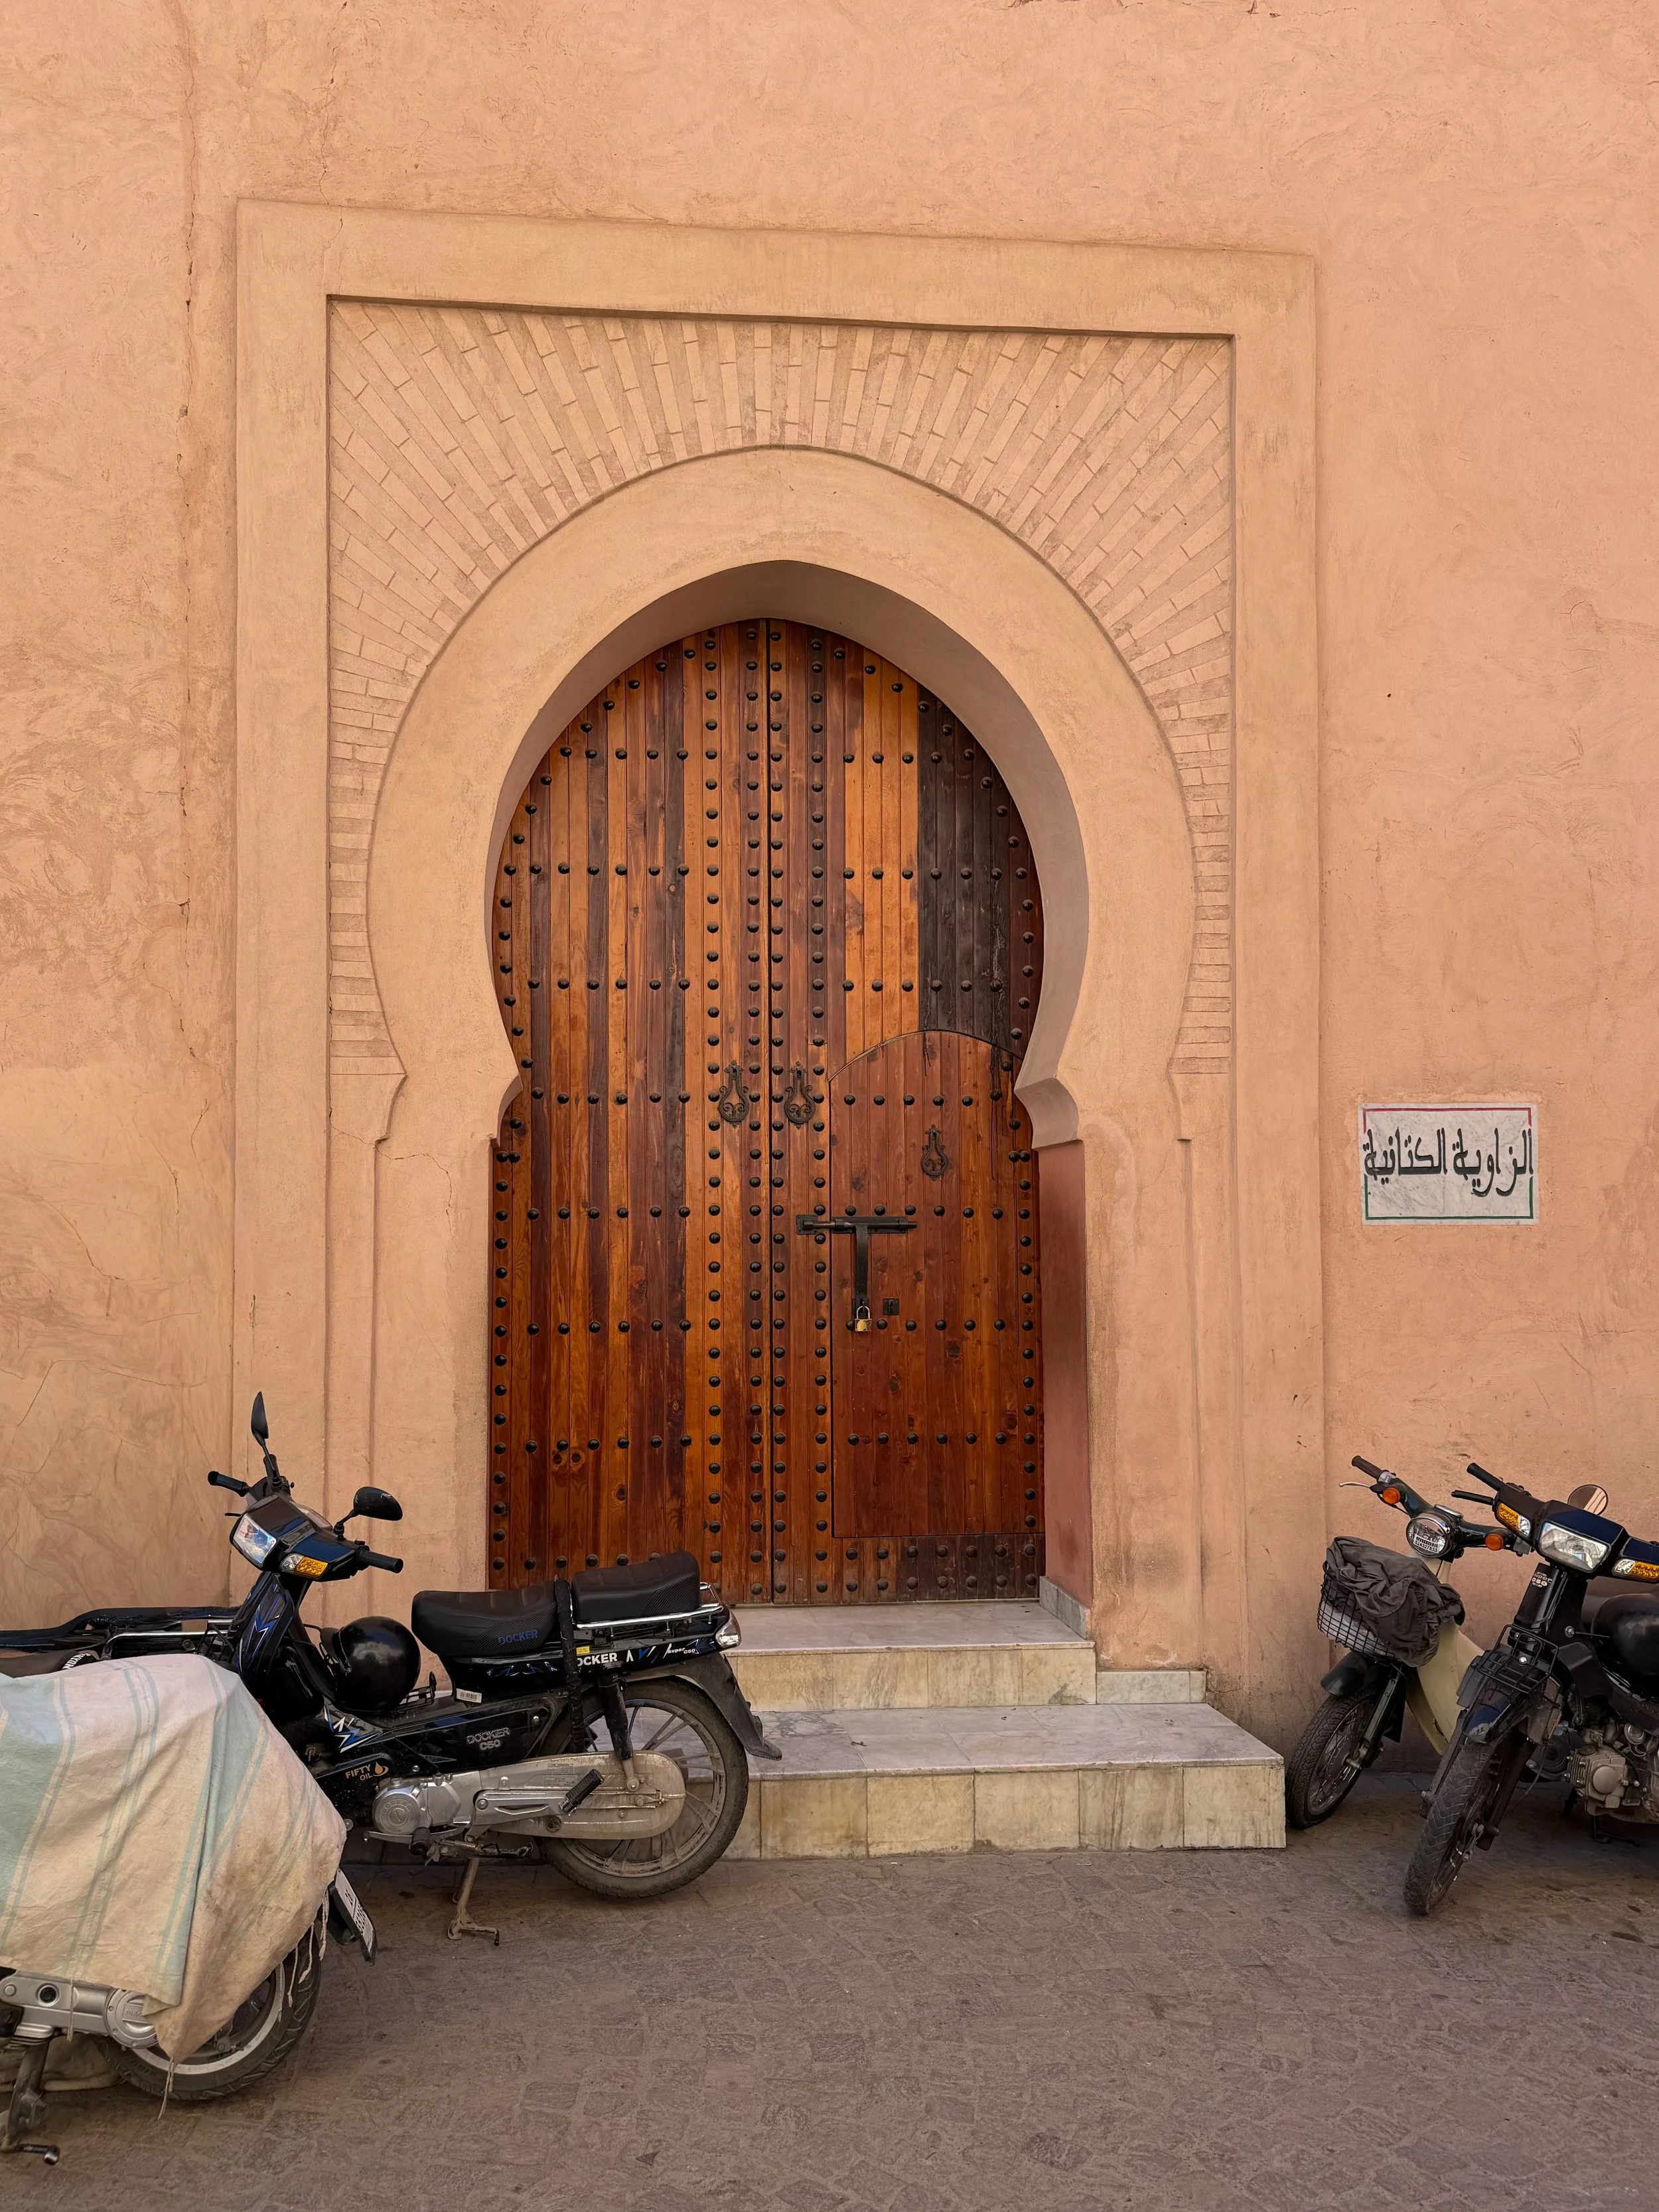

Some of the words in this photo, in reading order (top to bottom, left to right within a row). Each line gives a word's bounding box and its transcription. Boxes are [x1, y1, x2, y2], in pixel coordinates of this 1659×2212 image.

[1453, 1128, 1533, 1197] الزاوية
[498, 1629, 538, 1645] DOCKER
[577, 1652, 618, 1667] OCKER
[467, 1727, 510, 1744] DOCKER
[479, 1739, 501, 1751] C50
[345, 1763, 371, 1779] FIFTY
[360, 1773, 373, 1781] OIL
